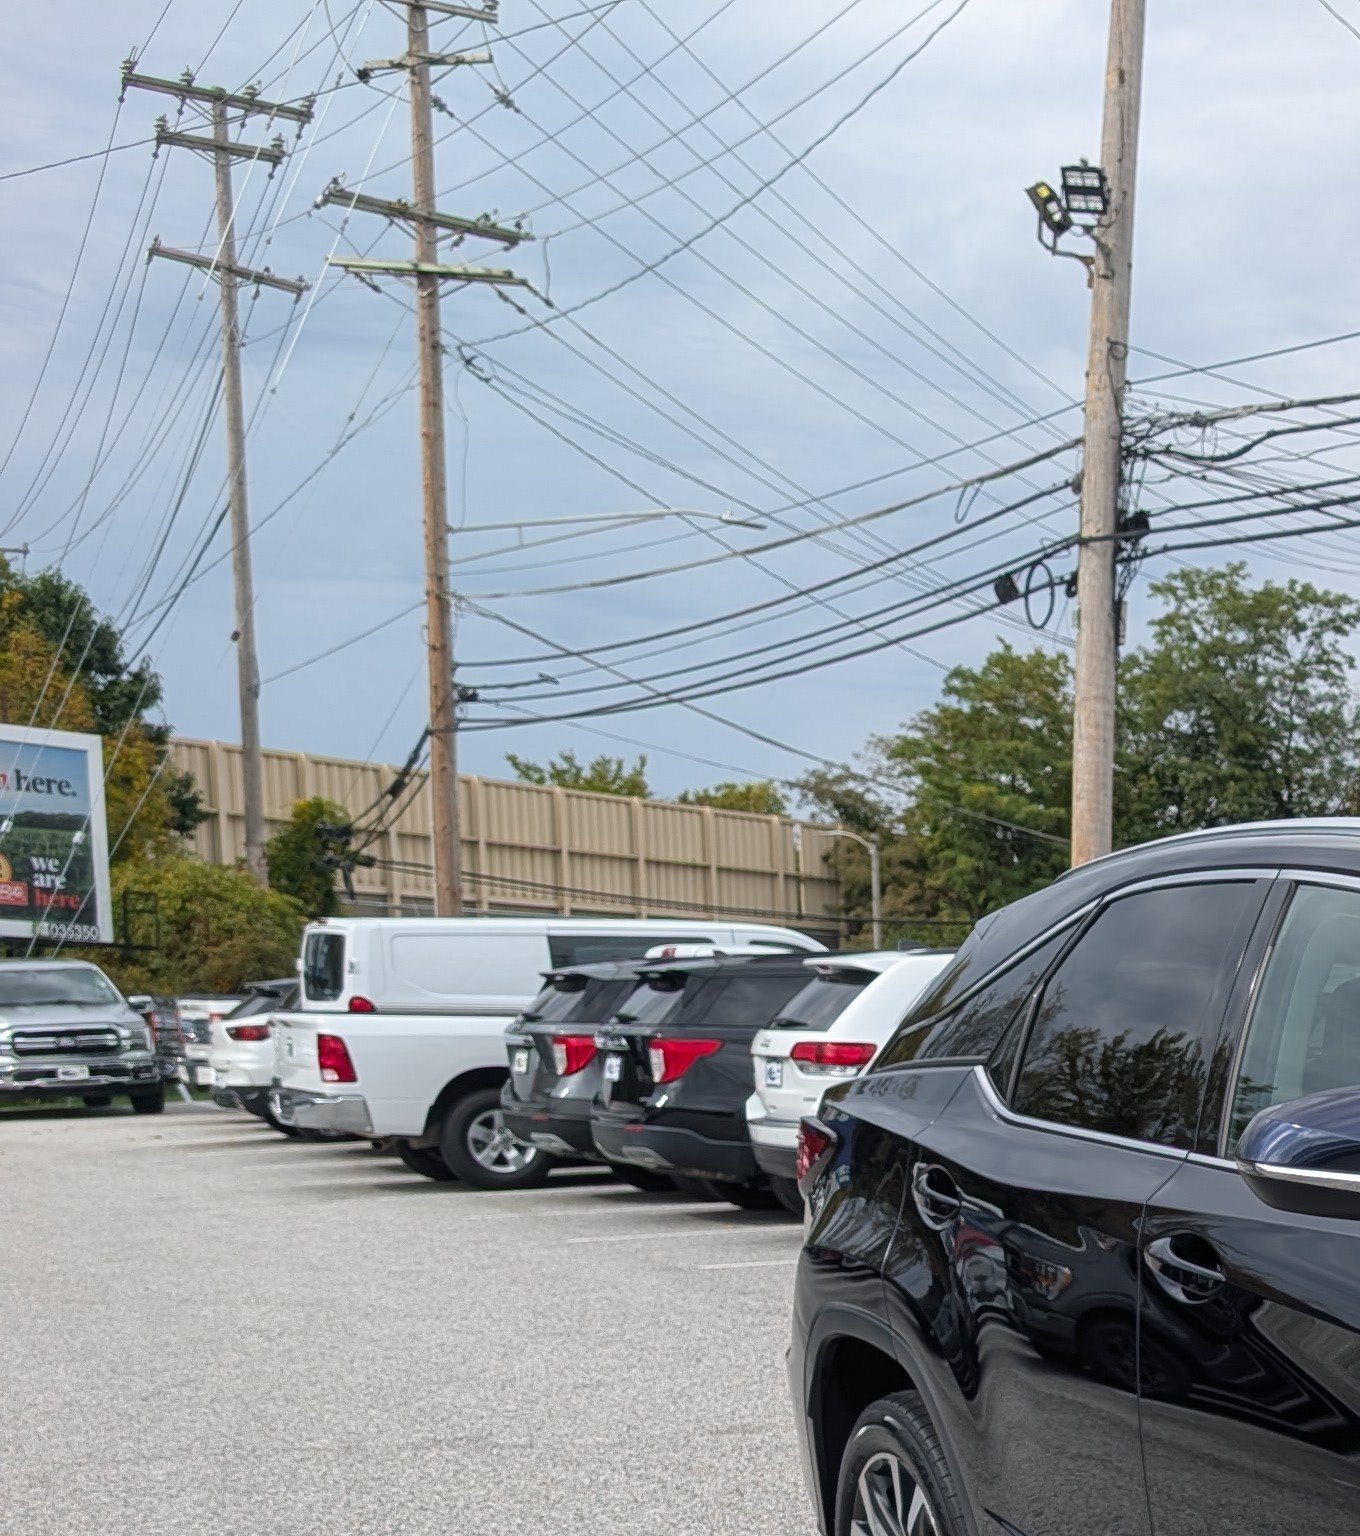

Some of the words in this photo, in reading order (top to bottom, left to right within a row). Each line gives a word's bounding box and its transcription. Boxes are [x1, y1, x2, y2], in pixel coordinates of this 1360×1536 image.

[15, 768, 77, 797] here.
[30, 856, 60, 873] we
[33, 872, 67, 889] are
